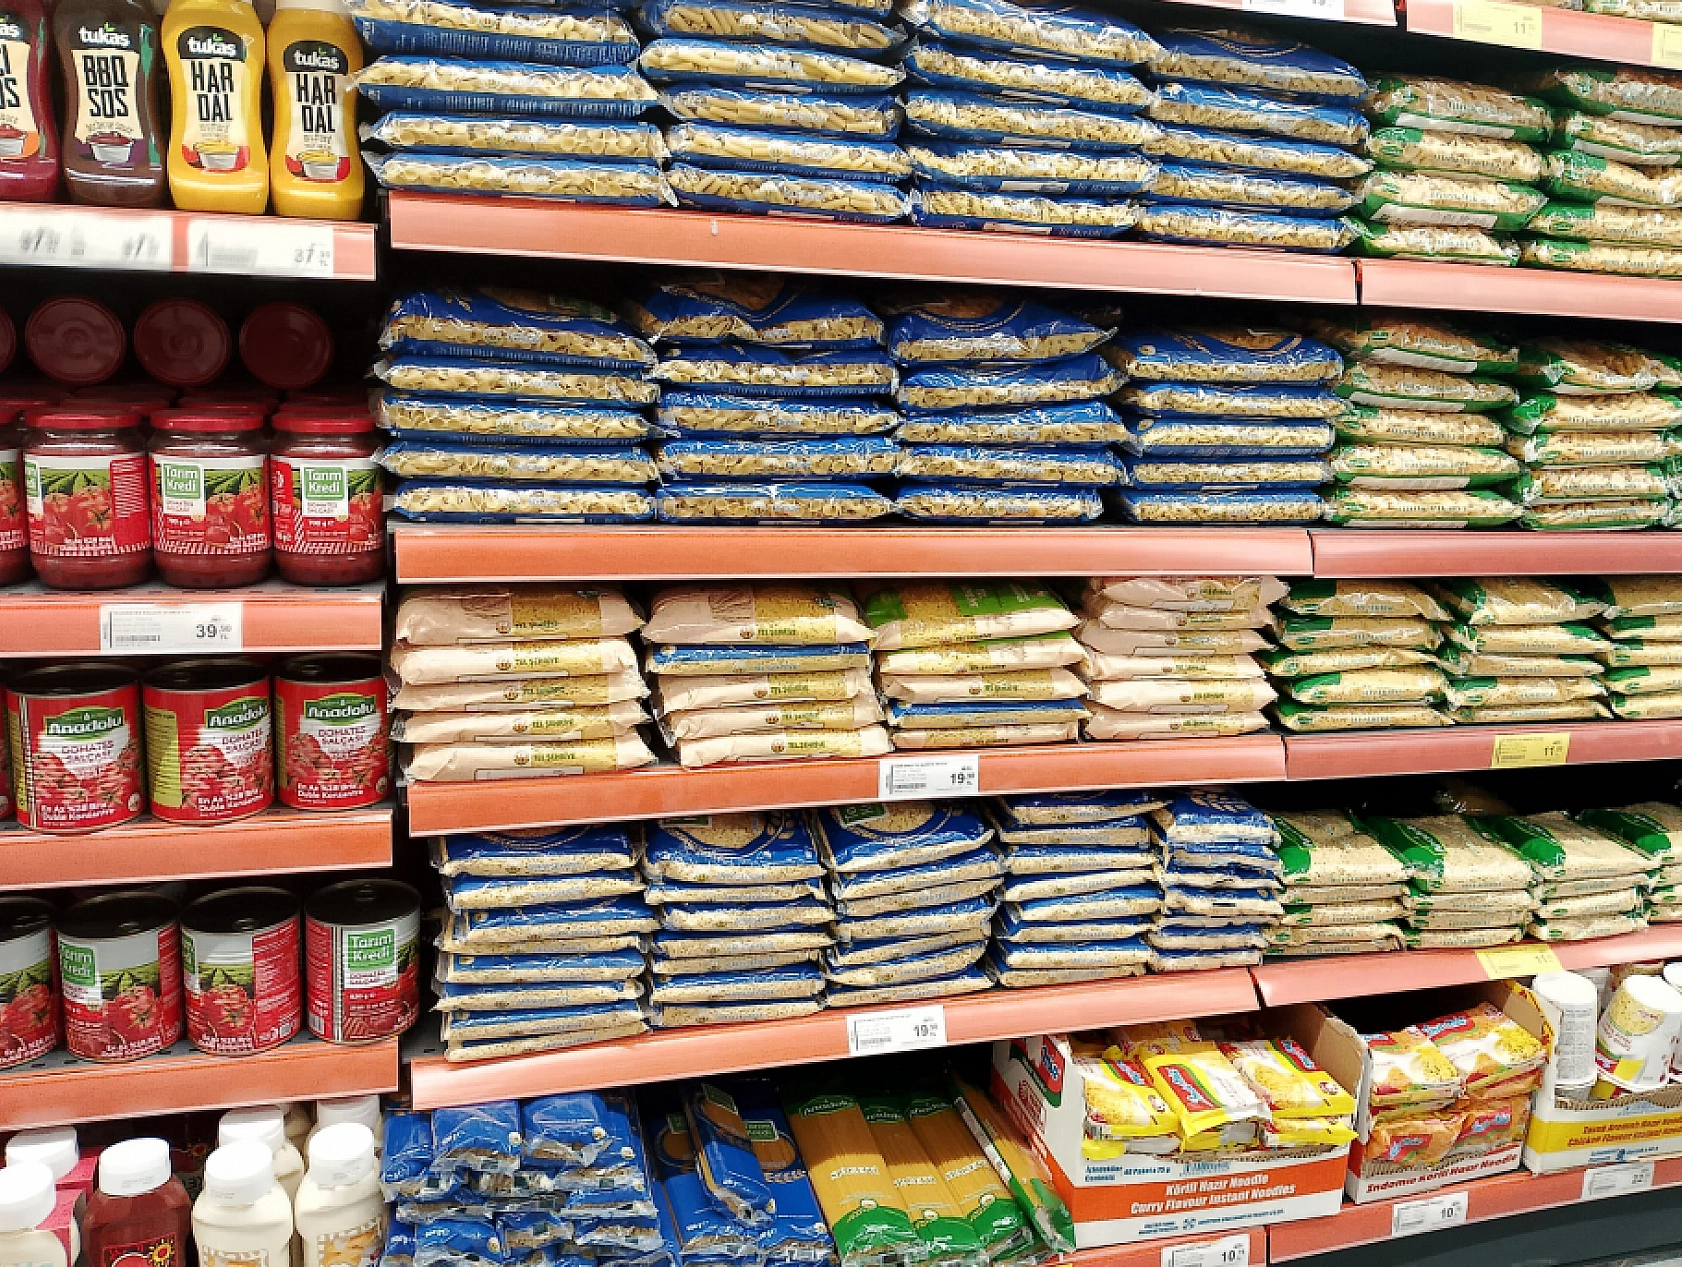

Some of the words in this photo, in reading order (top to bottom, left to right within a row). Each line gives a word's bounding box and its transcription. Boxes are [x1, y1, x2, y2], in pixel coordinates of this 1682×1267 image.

[82, 55, 129, 87] BBQ
[190, 61, 234, 92] HAR
[296, 74, 337, 105] HAR
[87, 88, 128, 118] SOS
[197, 94, 233, 122] DAL
[302, 105, 335, 133] DAL
[168, 480, 196, 492] Kredi
[309, 482, 340, 494] Kredi
[196, 624, 217, 639] 39
[209, 705, 268, 727] Anadolu
[308, 703, 375, 718] Anadolu
[49, 716, 122, 734] Anadolu
[354, 946, 390, 961] Kredi
[1131, 1202, 1164, 1215] Curry
[1250, 1185, 1297, 1200] Noodles
